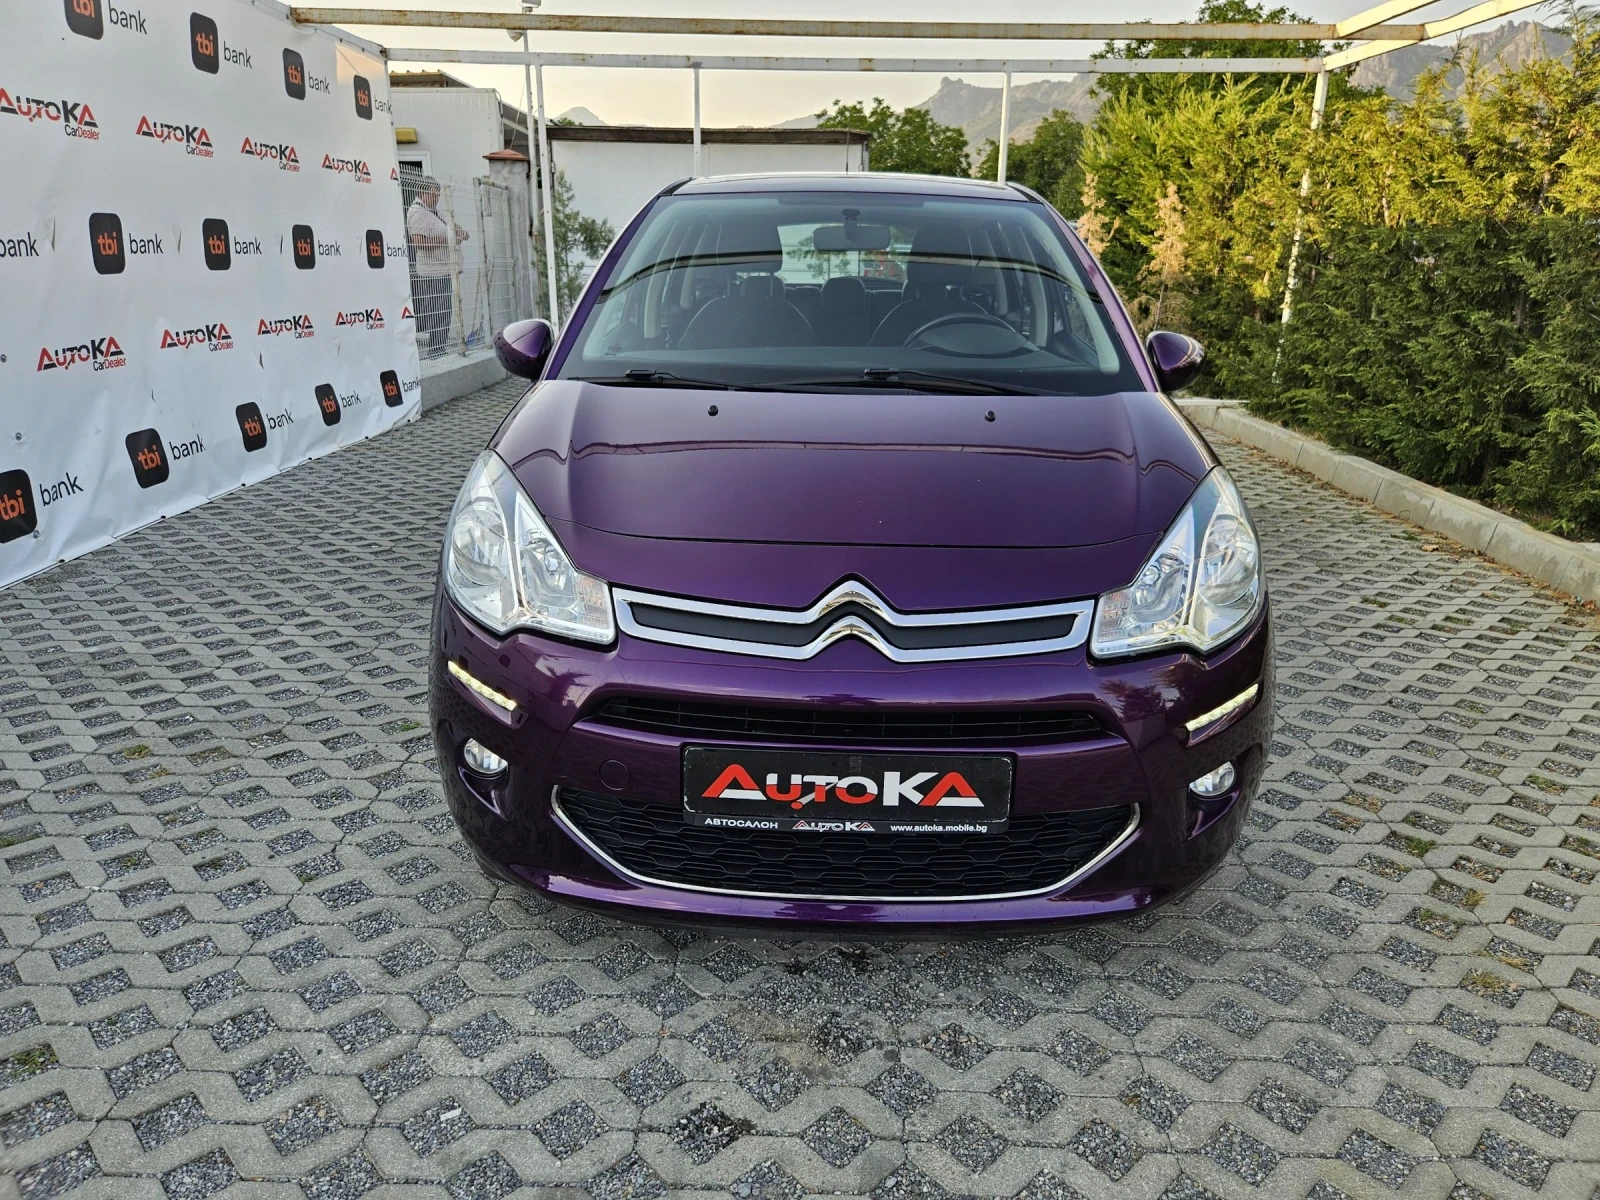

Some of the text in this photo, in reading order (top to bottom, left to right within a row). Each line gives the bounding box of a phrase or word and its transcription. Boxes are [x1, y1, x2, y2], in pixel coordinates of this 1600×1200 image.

[108, 0, 147, 35] bank
[196, 32, 252, 69] tbi bank
[287, 66, 330, 94] tbi bank
[357, 90, 393, 115] tbi bank
[64, 124, 100, 140] CarDealer
[186, 144, 214, 158] CarDealer
[97, 231, 163, 255] tbi bank
[208, 234, 262, 255] tbi bank
[297, 238, 341, 256] tbi bank
[370, 241, 408, 257] tbi bank
[93, 357, 126, 371] CarDealer
[384, 376, 420, 397] tbi bank
[322, 391, 361, 413] tbi bank
[244, 409, 294, 437] tbi bank
[137, 434, 205, 470] tbi bank
[0, 472, 84, 520] tbi bank
[702, 763, 985, 810] AUTOKA
[704, 817, 778, 830] АВТОСАЛОН
[890, 824, 988, 833] www.autoka.mobile.bg
